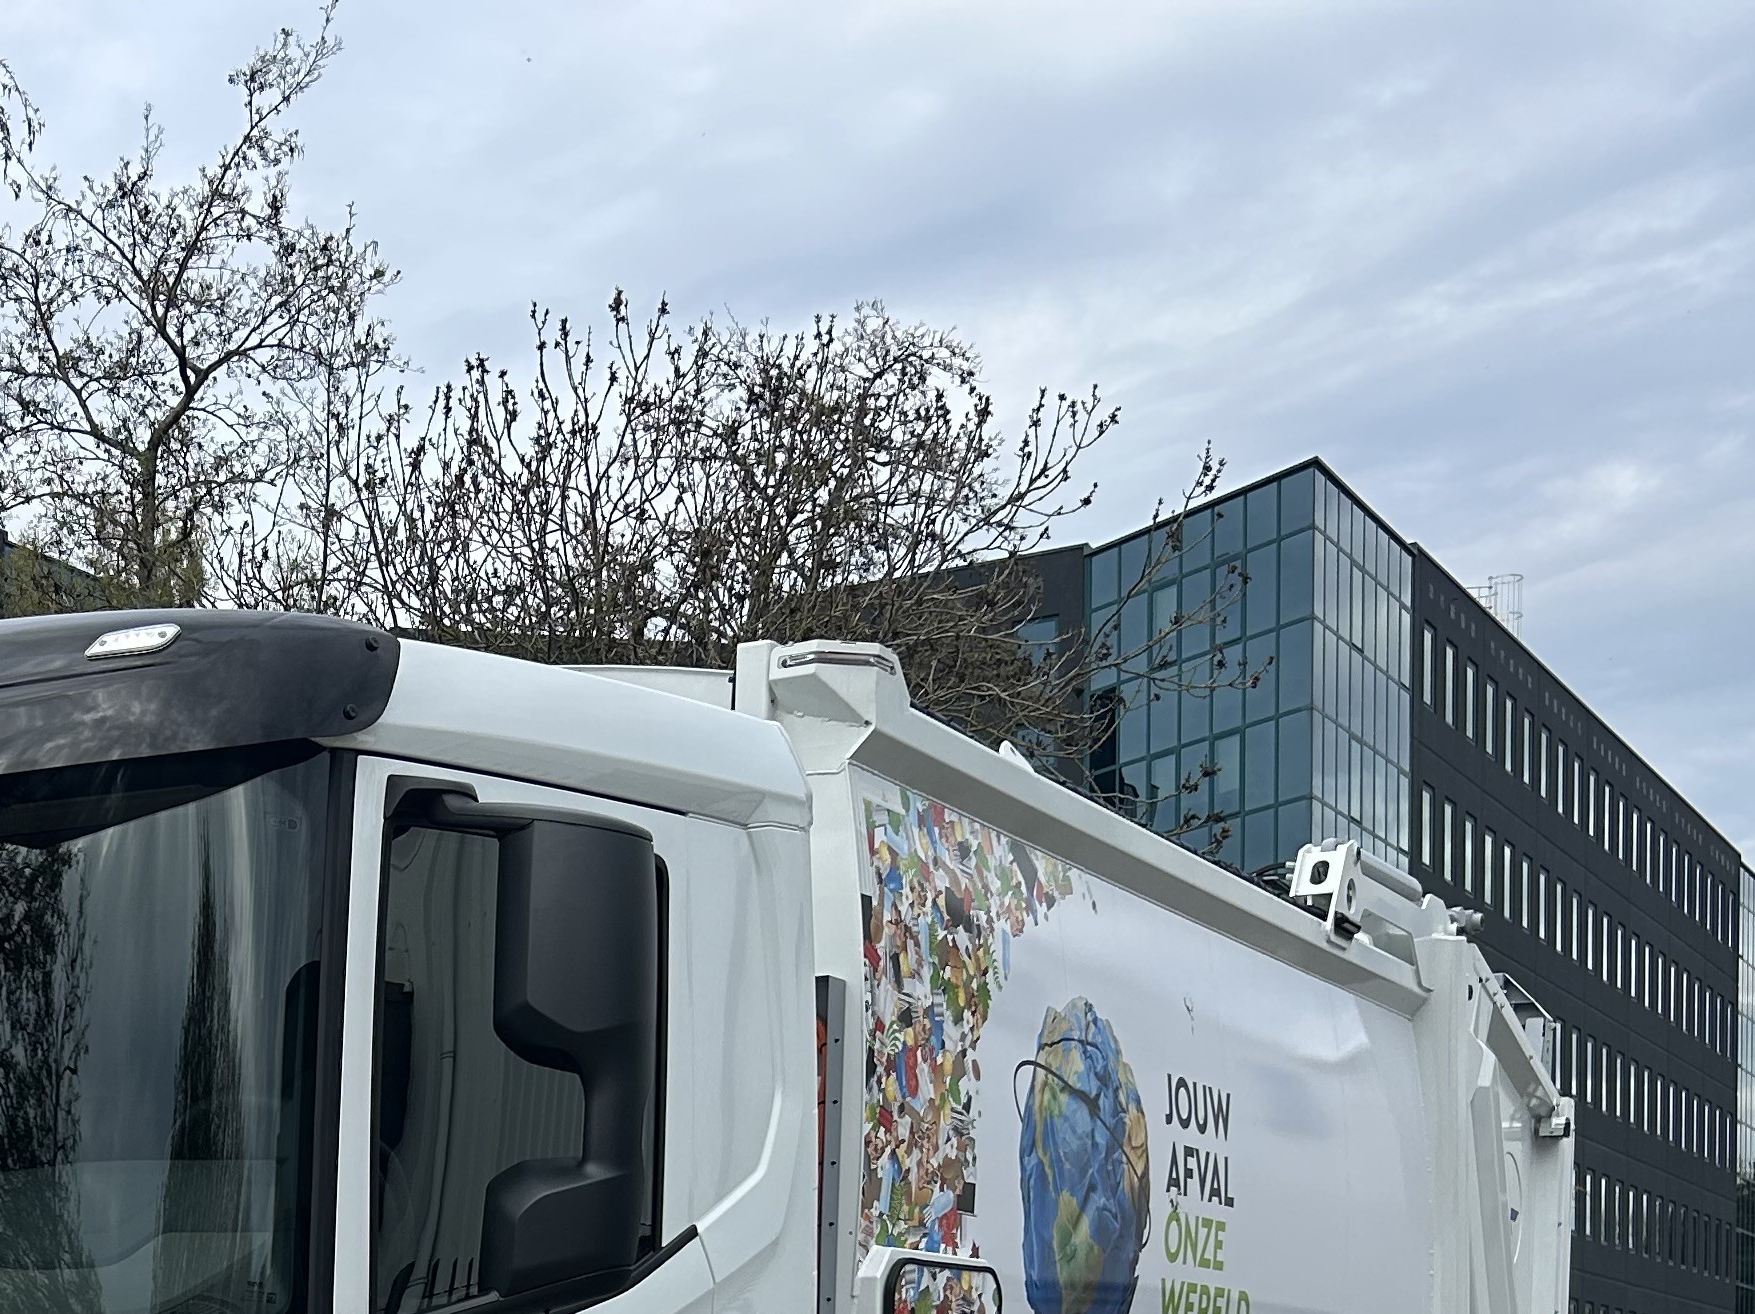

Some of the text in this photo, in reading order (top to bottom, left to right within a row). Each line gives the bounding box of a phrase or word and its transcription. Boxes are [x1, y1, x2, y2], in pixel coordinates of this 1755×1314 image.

[1165, 1073, 1231, 1141] JOUW
[1165, 1141, 1235, 1208] AFVAL
[1164, 1209, 1226, 1271] ONZE
